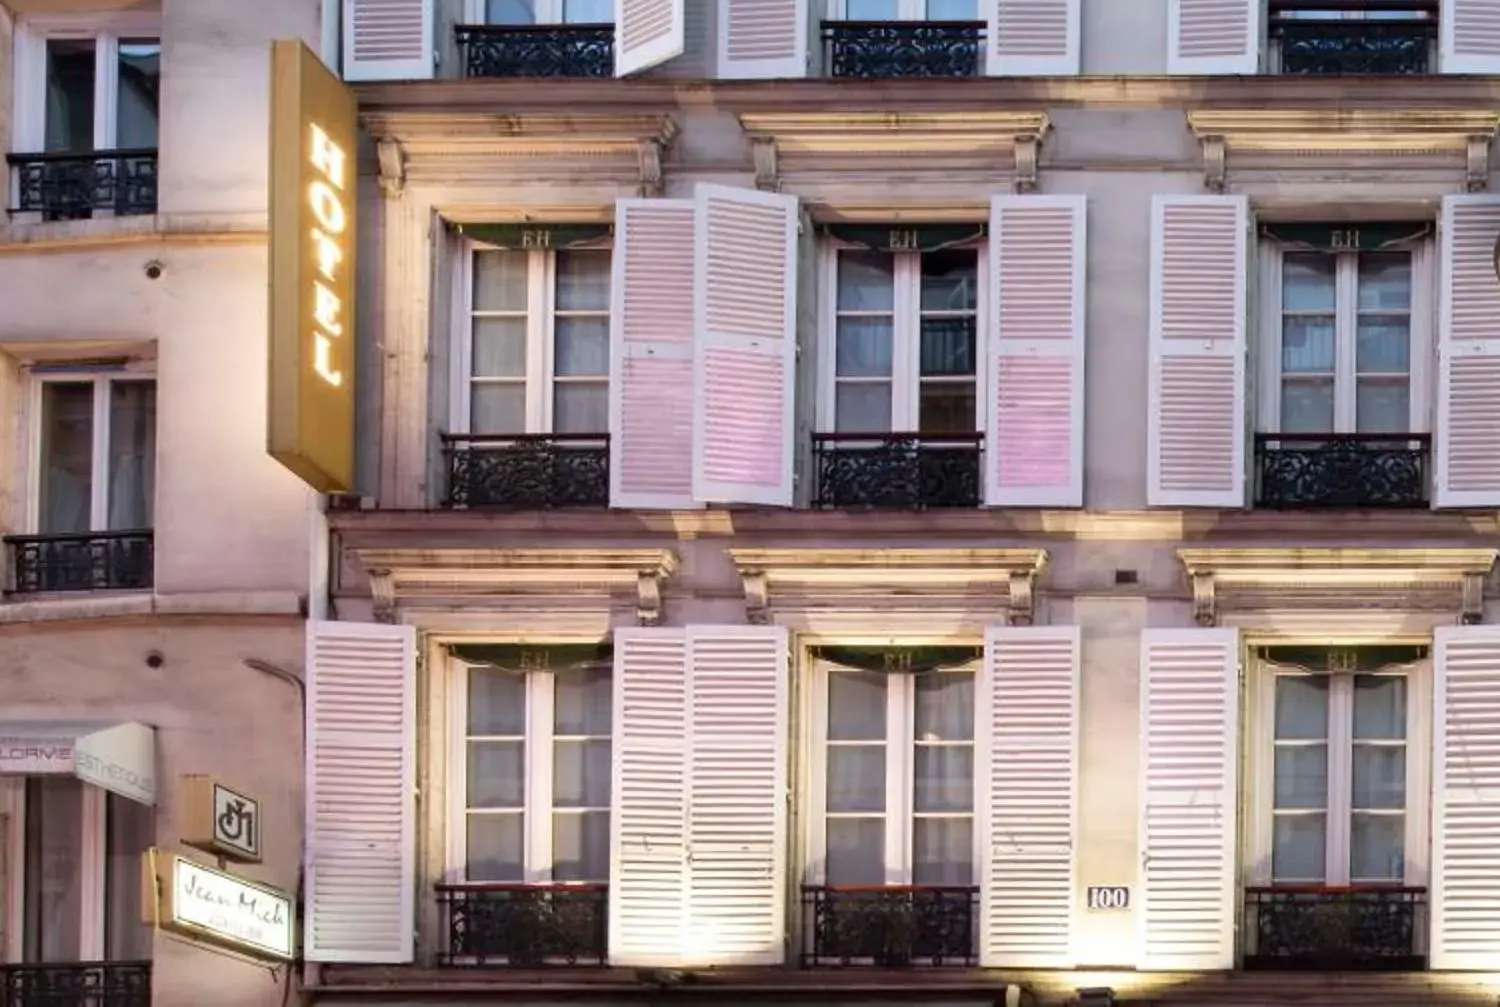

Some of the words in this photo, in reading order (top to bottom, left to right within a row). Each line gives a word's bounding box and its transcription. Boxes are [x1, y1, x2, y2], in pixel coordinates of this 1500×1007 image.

[308, 122, 346, 388] HOTEL
[184, 874, 231, 906] Jean
[1091, 888, 1126, 907] 100
